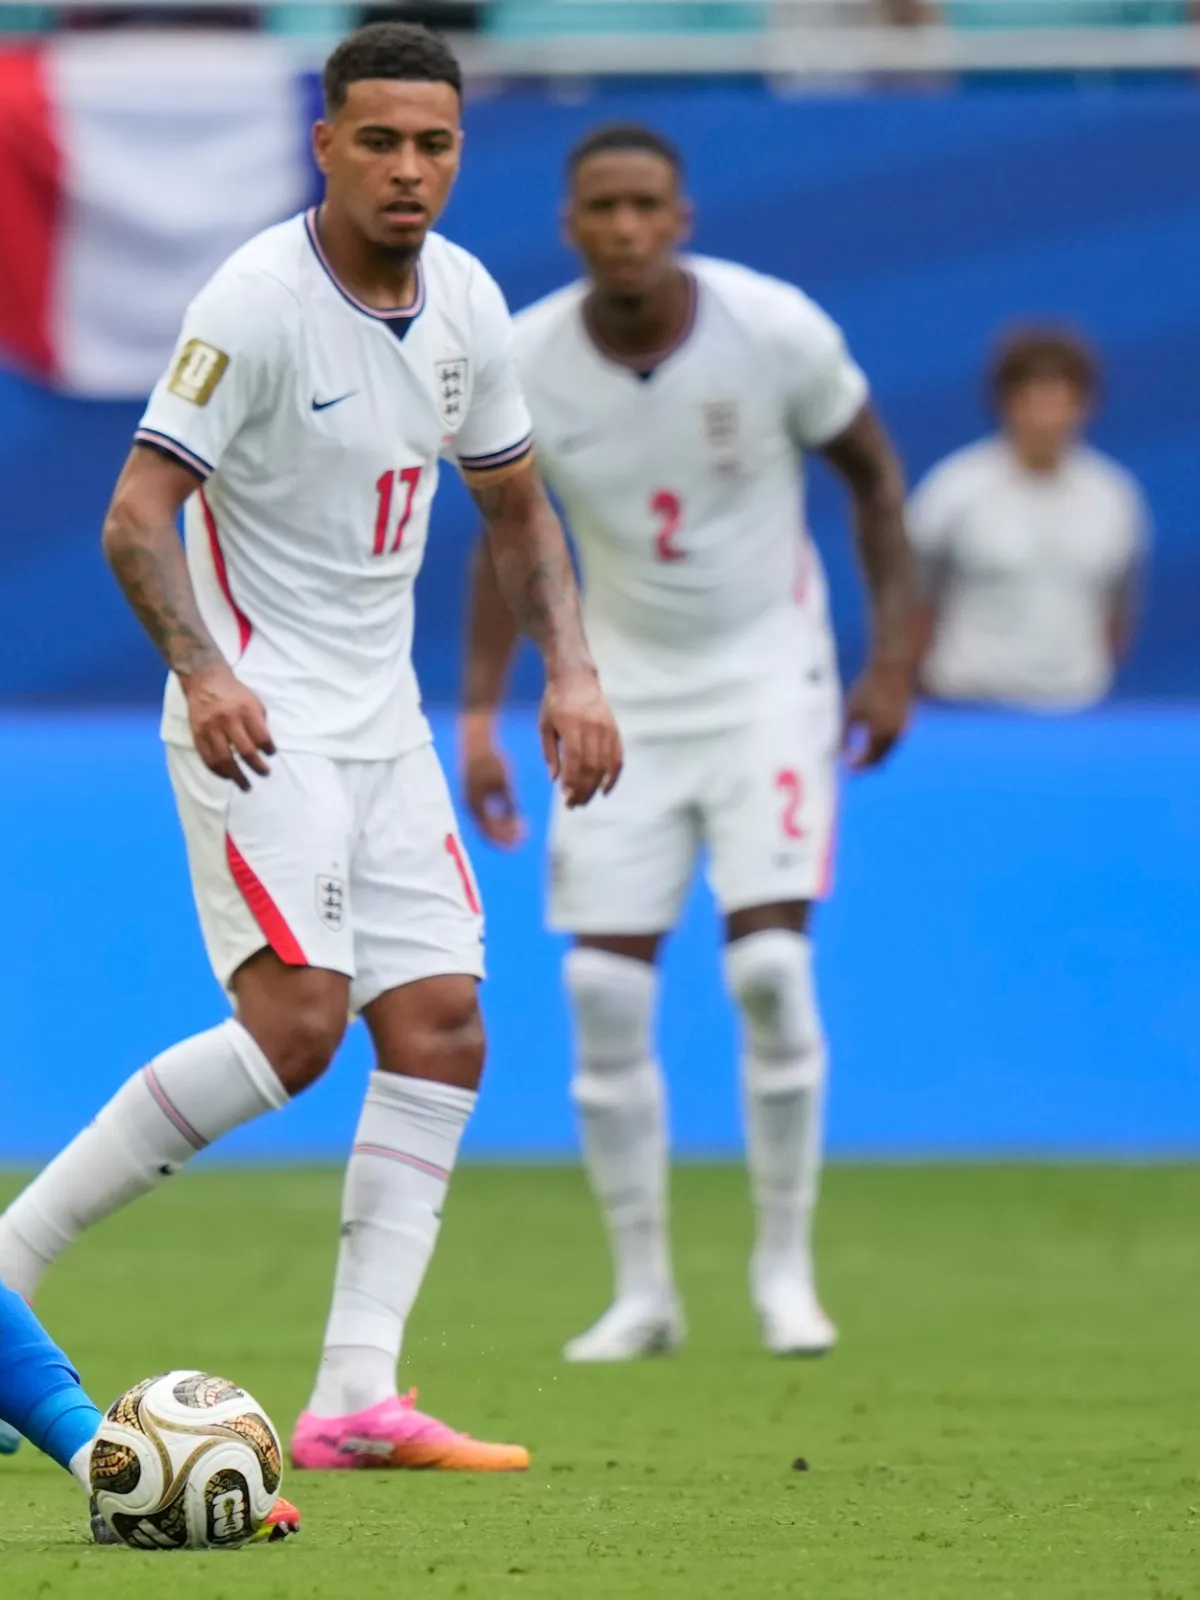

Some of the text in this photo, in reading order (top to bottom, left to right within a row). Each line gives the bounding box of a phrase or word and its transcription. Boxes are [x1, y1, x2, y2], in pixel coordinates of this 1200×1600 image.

[372, 466, 422, 557] 17
[649, 489, 687, 564] 2
[775, 768, 805, 839] 2
